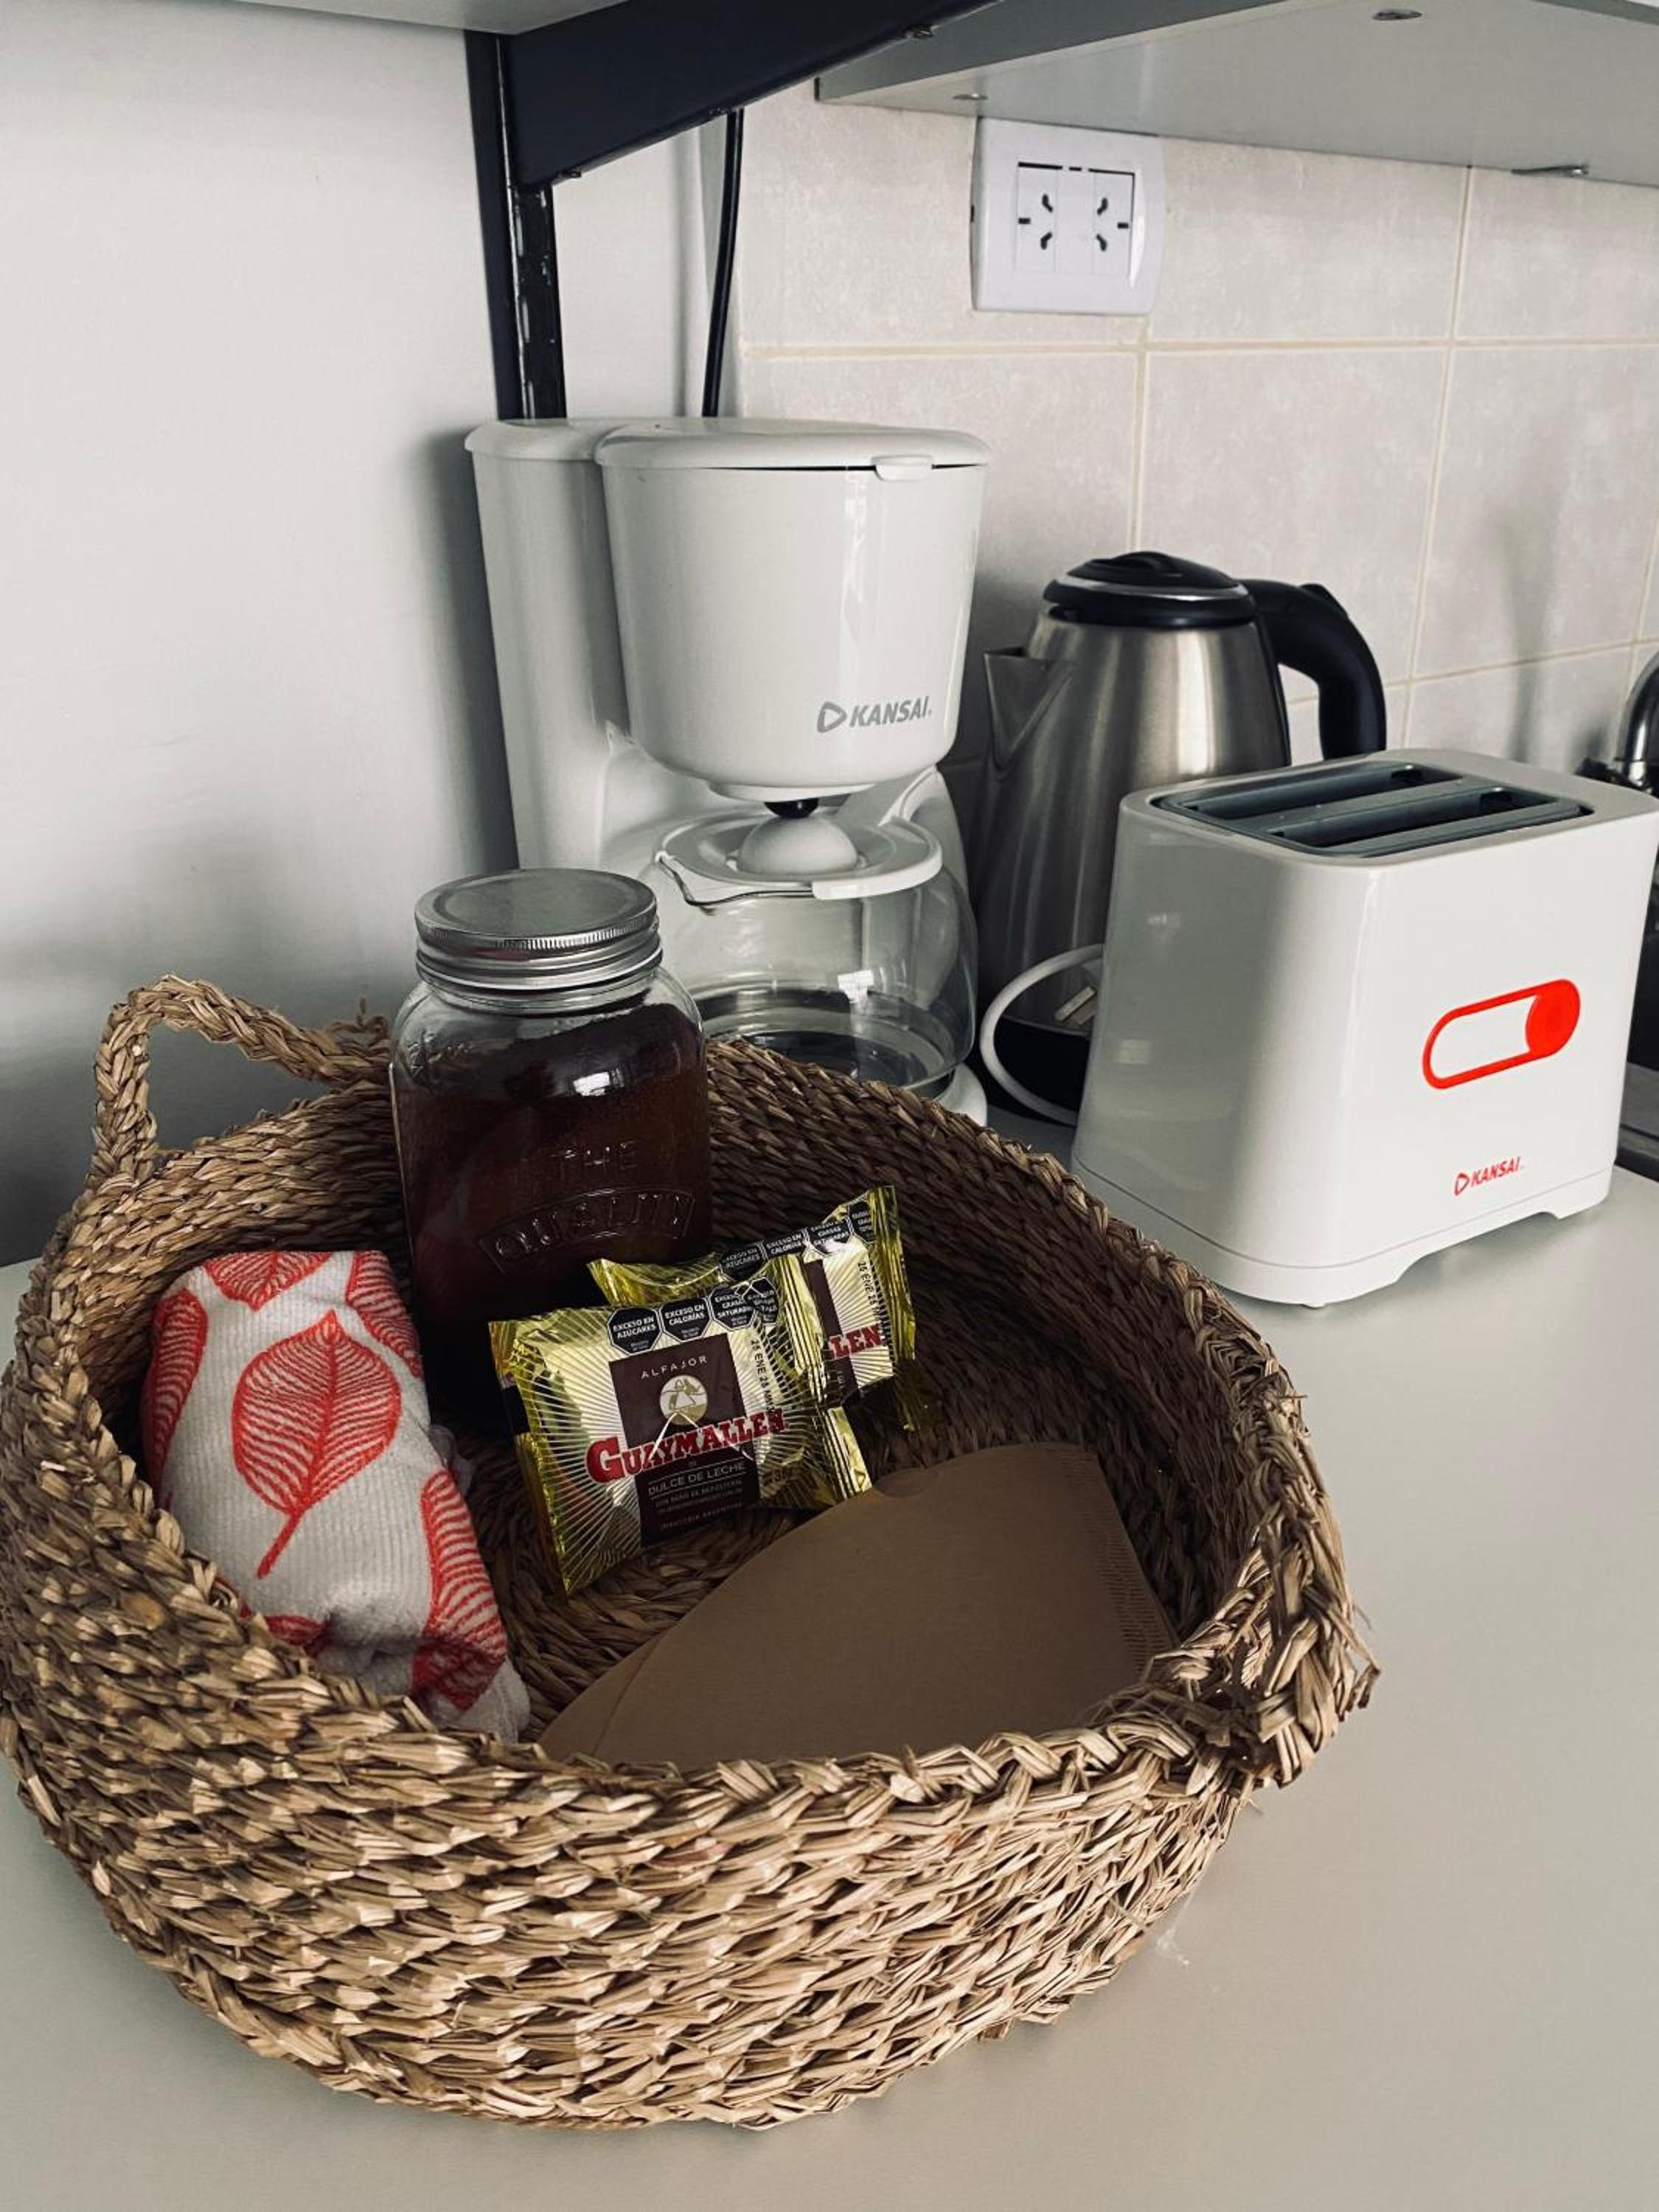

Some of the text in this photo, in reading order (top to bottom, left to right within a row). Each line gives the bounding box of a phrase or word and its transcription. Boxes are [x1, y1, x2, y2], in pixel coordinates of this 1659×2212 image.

[849, 696, 929, 727] KANSAI
[1471, 1155, 1521, 1187] KANSAI
[613, 1316, 654, 1332] EXCESO EN
[665, 1304, 705, 1319] EXCESO EN
[823, 1324, 882, 1362] LEN
[641, 1355, 708, 1380] ALFAJOR
[755, 1353, 767, 1374] ENE
[649, 1476, 684, 1495] DULCE
[688, 1471, 704, 1483] DE
[708, 1461, 745, 1478] LECHE
